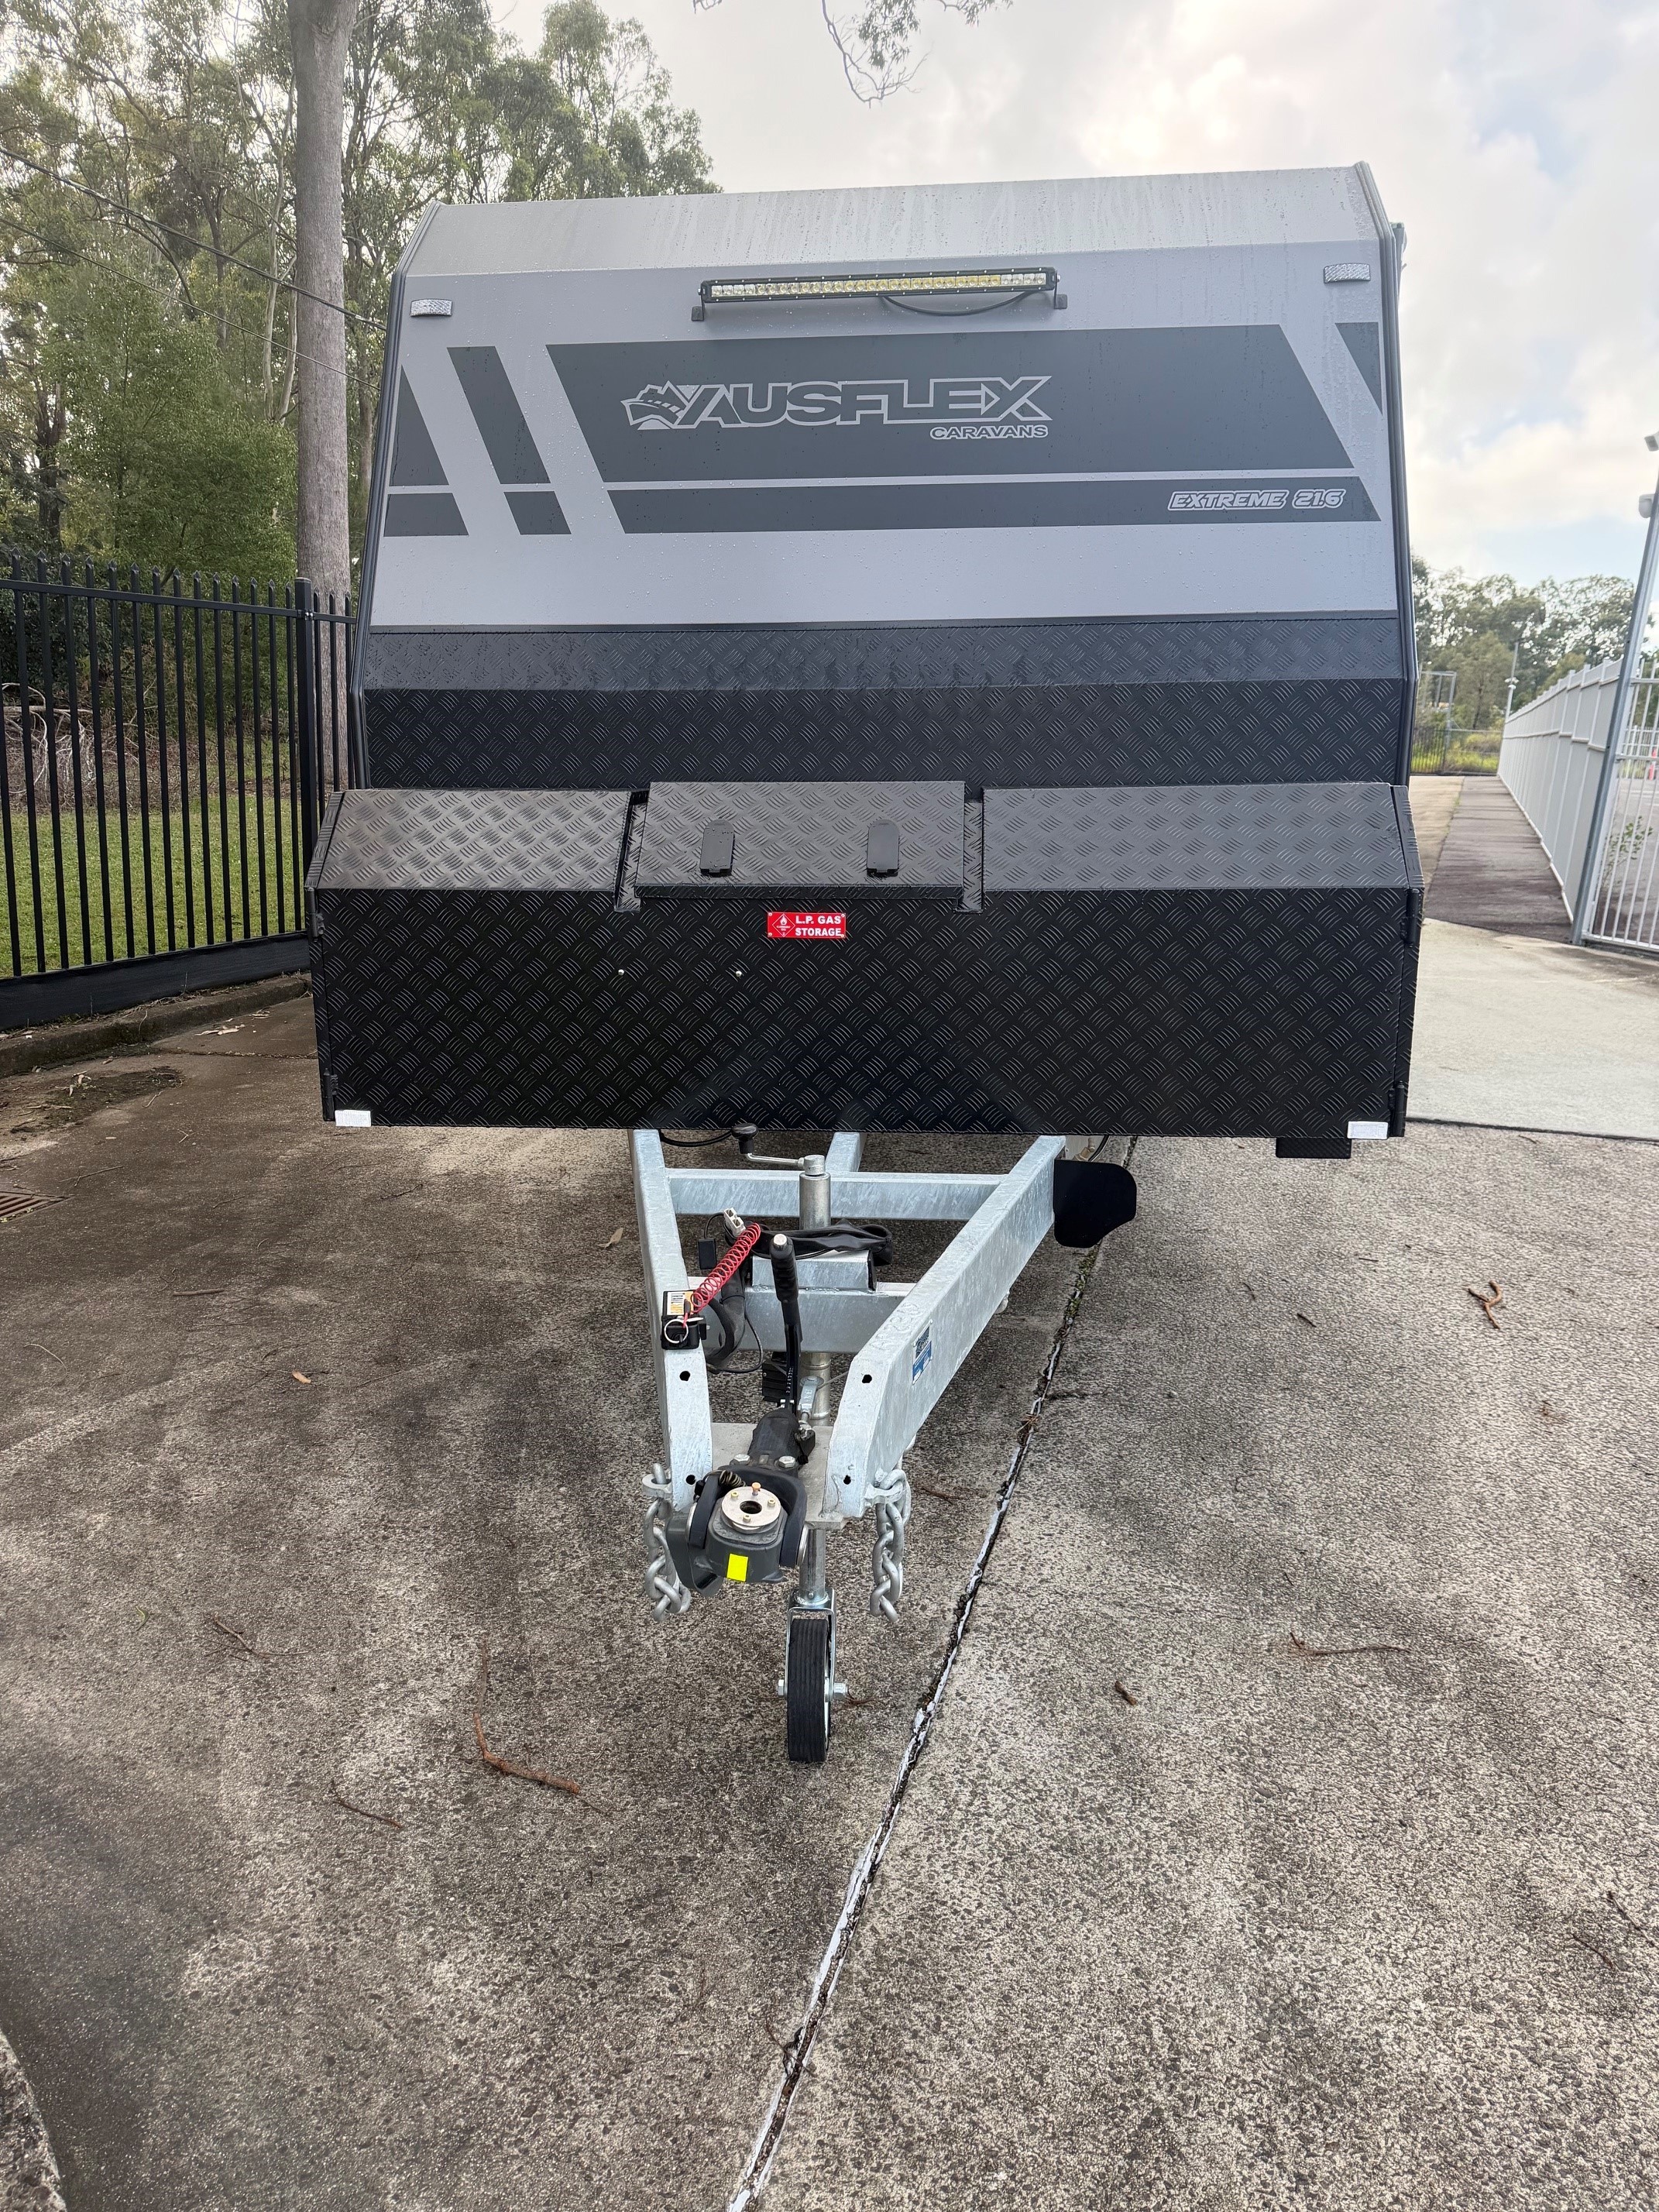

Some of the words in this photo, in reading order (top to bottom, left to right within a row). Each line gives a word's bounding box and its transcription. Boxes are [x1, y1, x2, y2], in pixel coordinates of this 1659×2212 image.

[675, 375, 1053, 428] AUSFLEX
[929, 424, 1049, 440] CARAVANS
[1167, 489, 1290, 510] EXTREME
[1293, 488, 1346, 509] 21.6
[795, 915, 814, 924] L.P.
[818, 915, 841, 925] GAS
[795, 927, 841, 936] STORAGE
